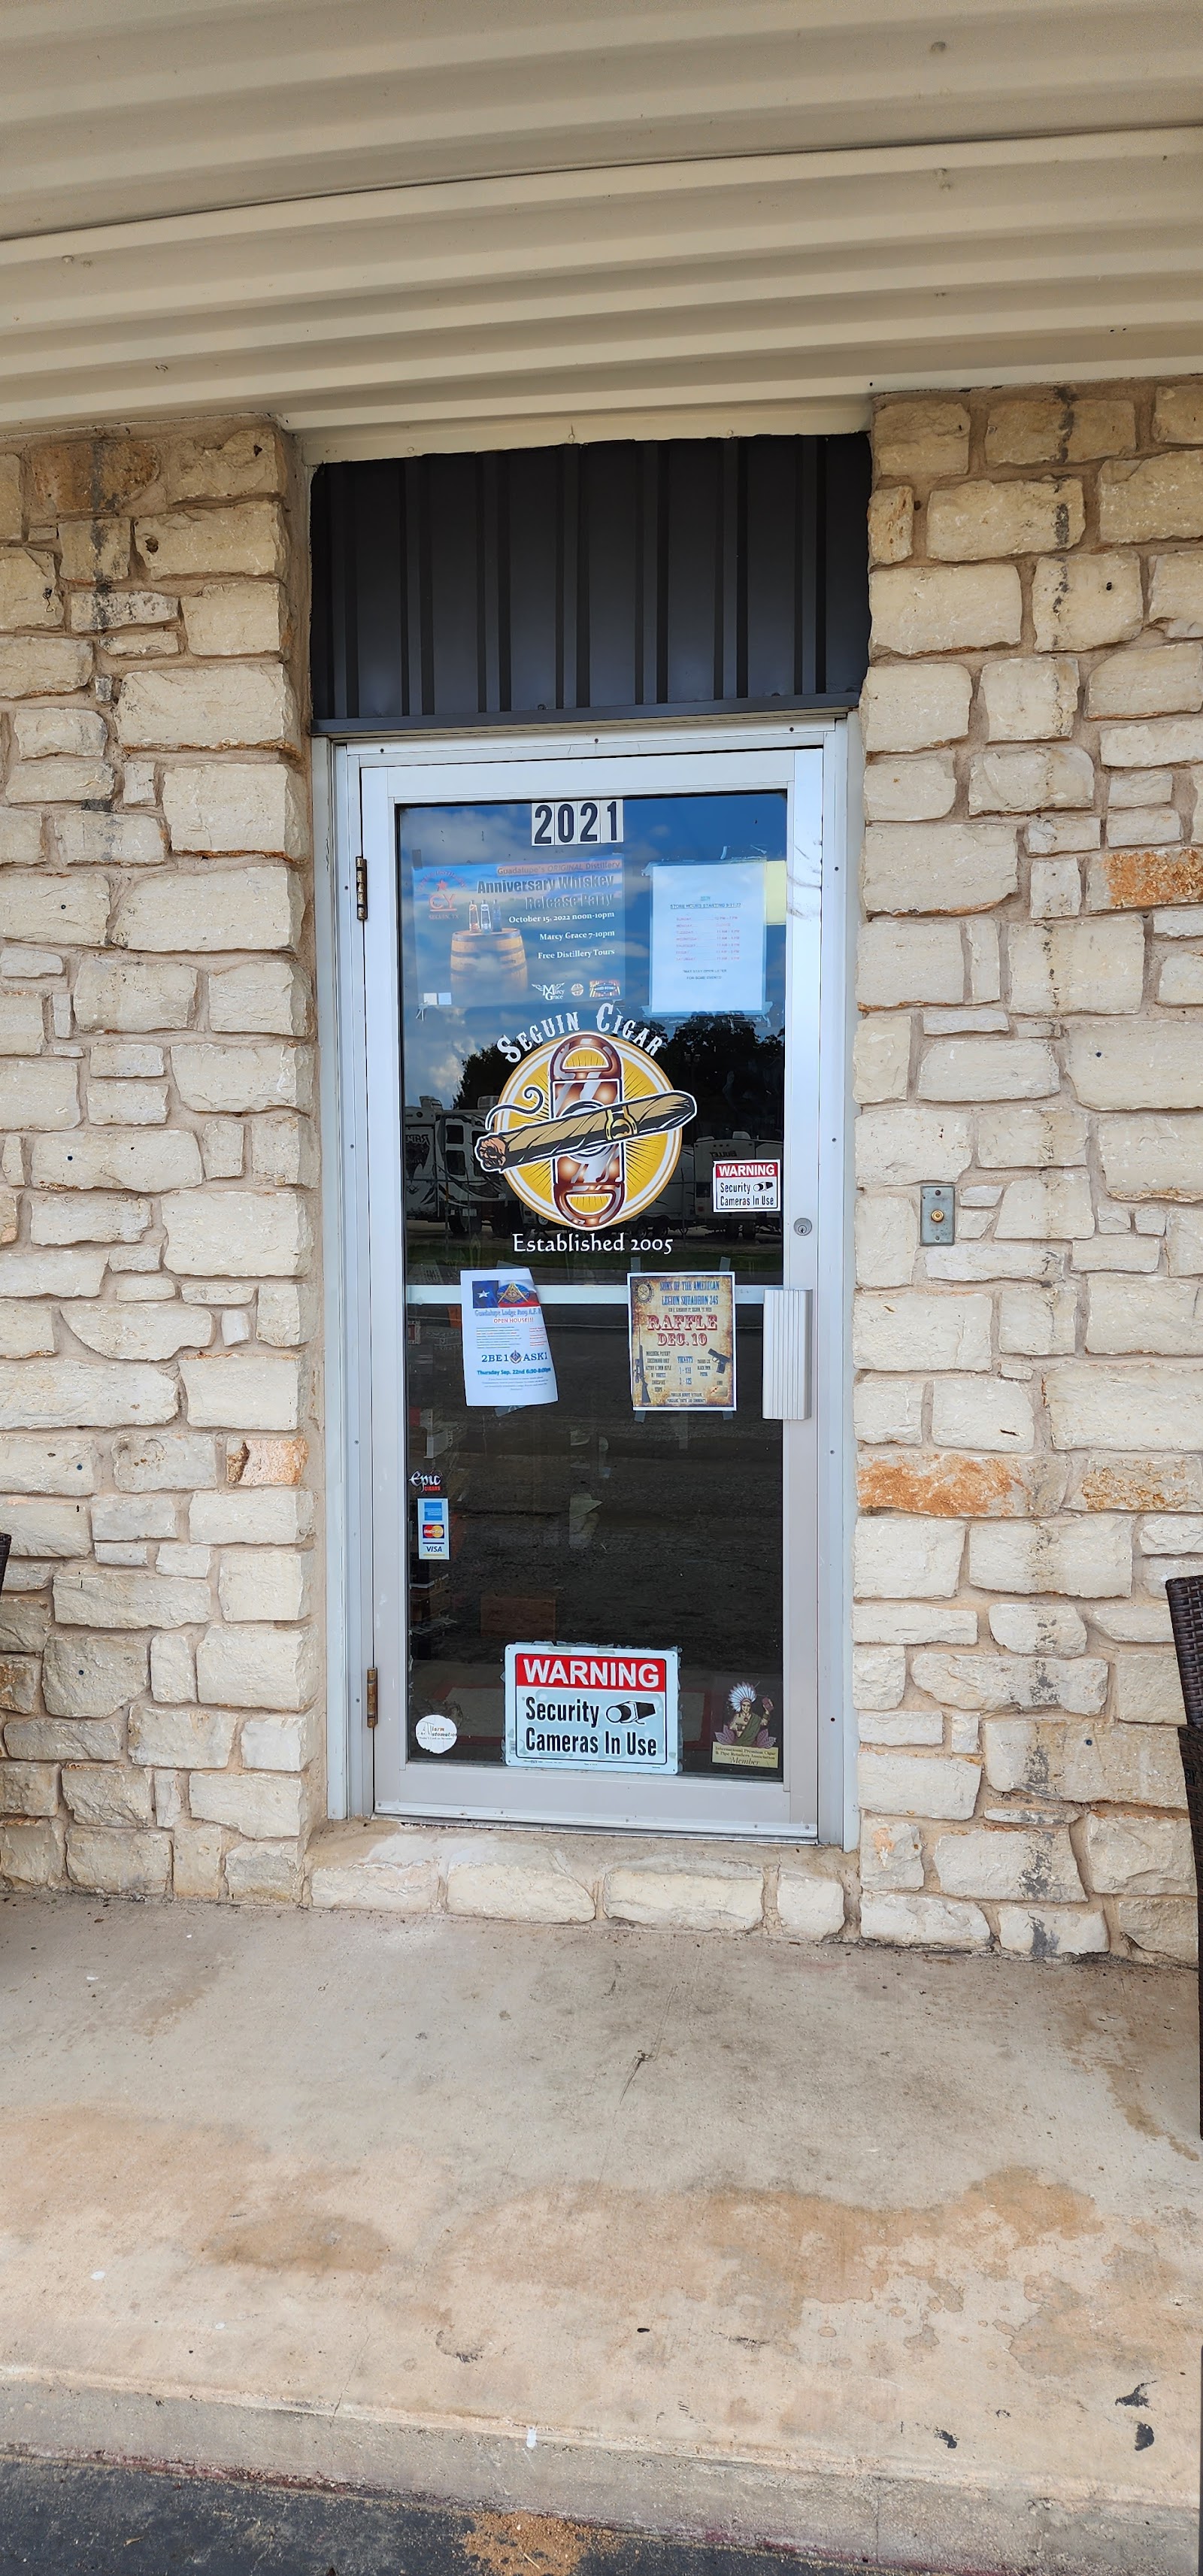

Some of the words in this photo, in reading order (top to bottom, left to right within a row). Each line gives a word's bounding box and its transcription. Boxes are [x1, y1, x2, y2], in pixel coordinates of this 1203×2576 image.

[535, 802, 617, 844] 2021
[497, 866, 544, 875] Guadalupe's
[547, 863, 583, 872] ORIGINAL
[586, 861, 621, 871] Distillery
[477, 878, 556, 893] Anniversary
[558, 874, 614, 889] Whiskey
[526, 896, 578, 910] Release
[580, 893, 614, 907] Party
[571, 911, 615, 921] noon-10pm
[540, 933, 563, 941] Marcy
[588, 930, 615, 939] 7-10pm
[557, 950, 592, 959] Distillery
[542, 985, 565, 996] Marcy
[545, 992, 563, 1001] Grace
[497, 1011, 580, 1062] SEGUIN
[595, 1002, 664, 1056] CIGAR
[718, 1164, 775, 1177] WARNING
[720, 1182, 750, 1195] Security
[720, 1196, 750, 1207] Cameras
[753, 1196, 759, 1205] In
[762, 1195, 774, 1205] Use
[512, 1232, 624, 1253] Established
[631, 1238, 674, 1255] 2005
[673, 1281, 680, 1291] OF
[681, 1280, 692, 1291] THE
[692, 1280, 720, 1291] AMERICAN
[662, 1296, 680, 1305] LEGION
[680, 1295, 708, 1306] SQUADRON
[502, 1309, 517, 1317] Lodge
[647, 1314, 717, 1331] RAFFLE
[657, 1333, 689, 1346] DEC.
[692, 1333, 708, 1347] 10
[481, 1354, 509, 1362] 2BE1
[523, 1352, 548, 1362] ASK1
[523, 1659, 659, 1688] WARNING
[526, 1696, 599, 1728] Security
[526, 1727, 598, 1754] Cameras
[605, 1731, 620, 1755] In
[627, 1732, 657, 1756] Use
[730, 1756, 760, 1766] Member
